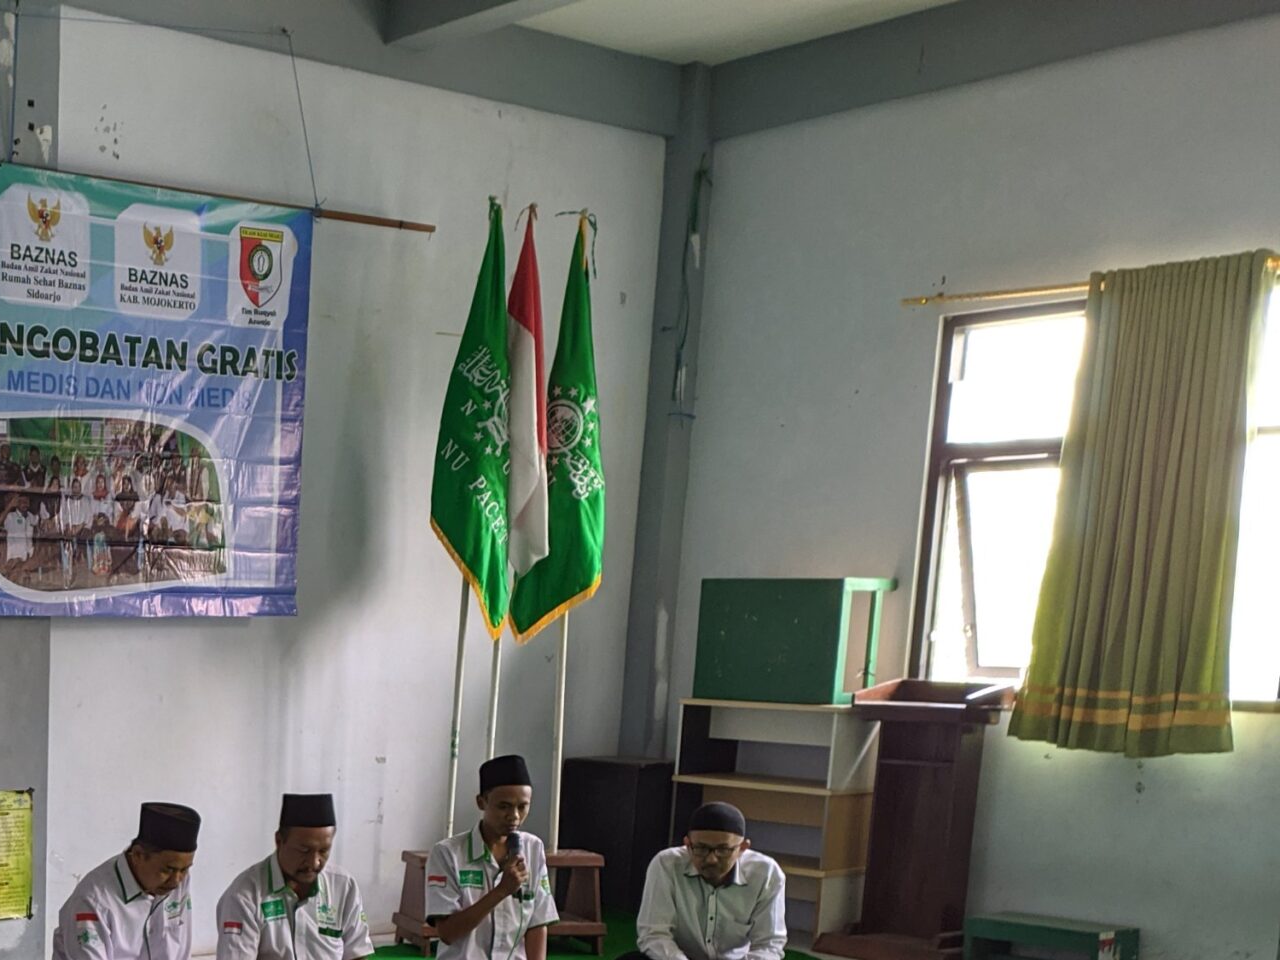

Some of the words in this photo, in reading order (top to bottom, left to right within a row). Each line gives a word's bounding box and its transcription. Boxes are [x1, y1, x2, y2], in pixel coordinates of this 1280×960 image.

[10, 244, 78, 268] BAZNAS
[1, 261, 22, 271] Badan
[23, 263, 38, 273] Amil
[39, 265, 58, 275] Zakat
[60, 267, 86, 279] Nasional
[128, 268, 189, 289] BAZNAS
[1, 271, 32, 285] Rumah
[33, 275, 56, 287] Sehat
[58, 279, 86, 291] Baznas
[26, 289, 61, 302] Sidoarjo
[120, 284, 138, 292] Badan
[140, 286, 153, 294] Amil
[154, 287, 171, 296] Zakat
[172, 290, 195, 299] Nasional
[120, 294, 140, 305] KAB.
[142, 297, 195, 311] MOJOKERTO
[196, 342, 298, 382] GRATIS
[7, 370, 77, 397] MEDIS
[85, 378, 131, 400] DAN
[188, 387, 252, 412] MEDS
[441, 438, 470, 471] NU
